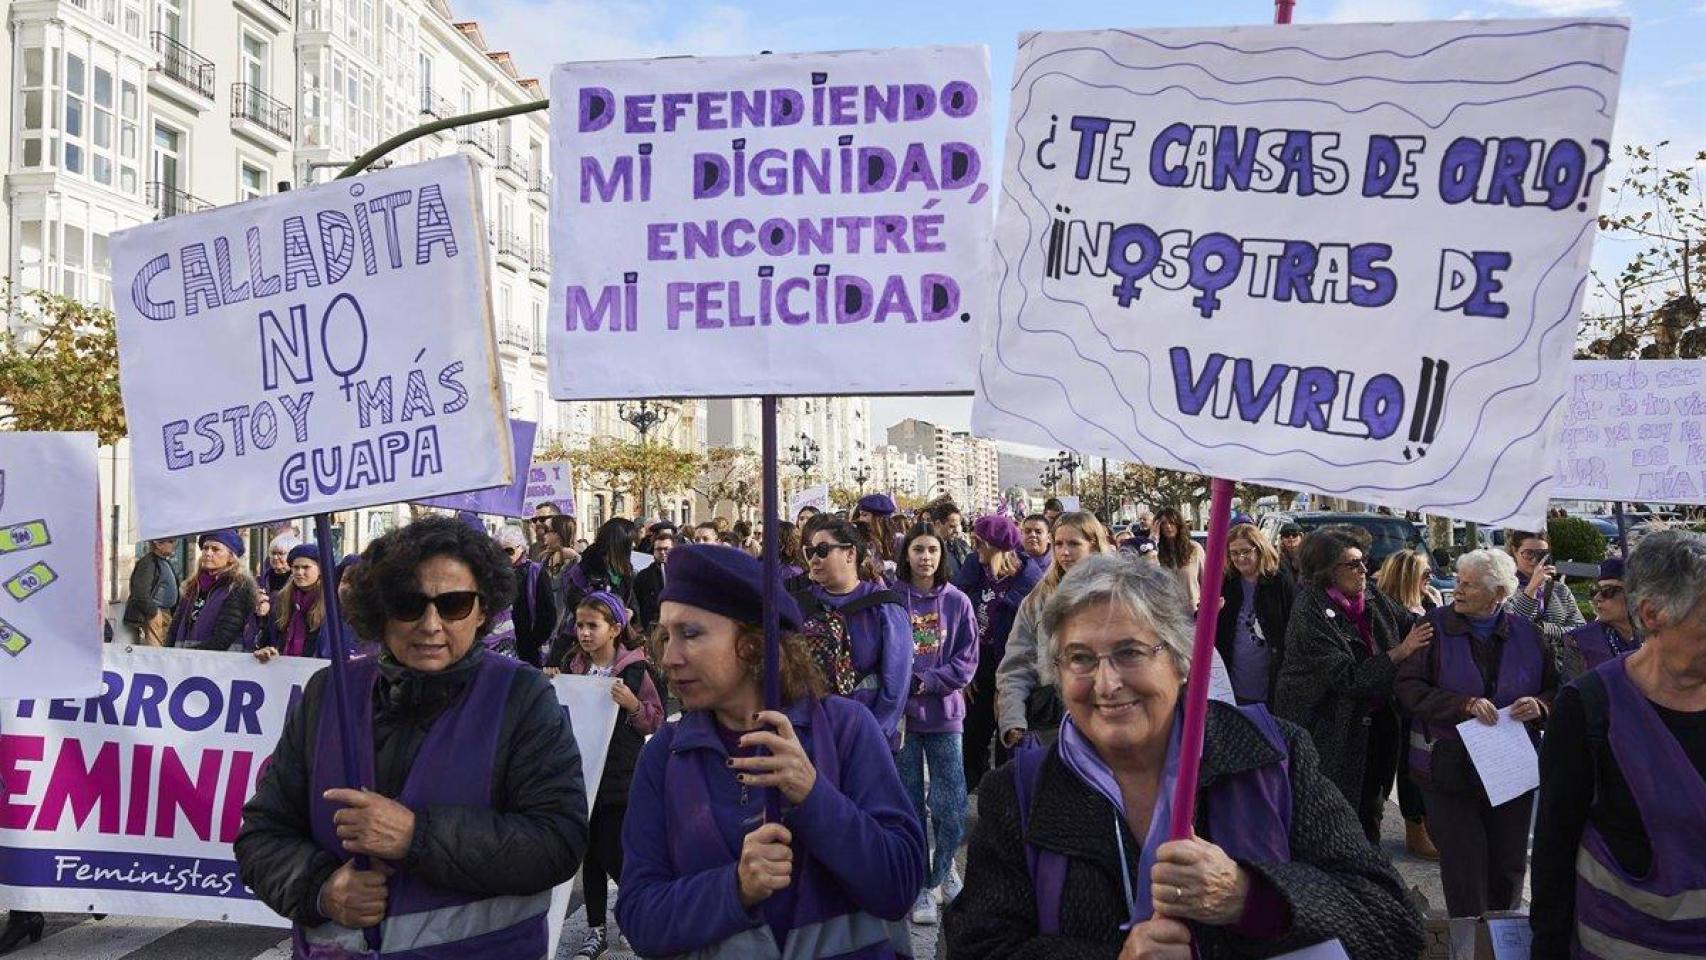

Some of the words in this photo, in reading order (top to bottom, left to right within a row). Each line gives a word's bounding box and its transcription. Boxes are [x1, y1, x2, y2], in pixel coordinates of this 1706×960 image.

[578, 72, 978, 132] DEFENDIENDO
[580, 143, 653, 203] MI
[693, 135, 989, 204] DIGNIDAD,
[1149, 122, 1350, 197] CANSAS
[1362, 134, 1426, 199] DE
[1439, 136, 1610, 212] OIRLO?
[132, 183, 458, 320] CALLADITA
[647, 198, 946, 260] ENCONTRÉ
[566, 272, 638, 332] MI
[666, 264, 970, 330] FELICIDAD.
[1434, 249, 1512, 319] DE
[260, 293, 367, 402] NO
[162, 391, 314, 470] ESTOY
[356, 348, 469, 429] MÁS
[1169, 347, 1449, 459] VIVIRLO!!
[279, 425, 443, 503] GUAPA
[0, 734, 272, 845] EMINI
[54, 855, 236, 892] Feministas
